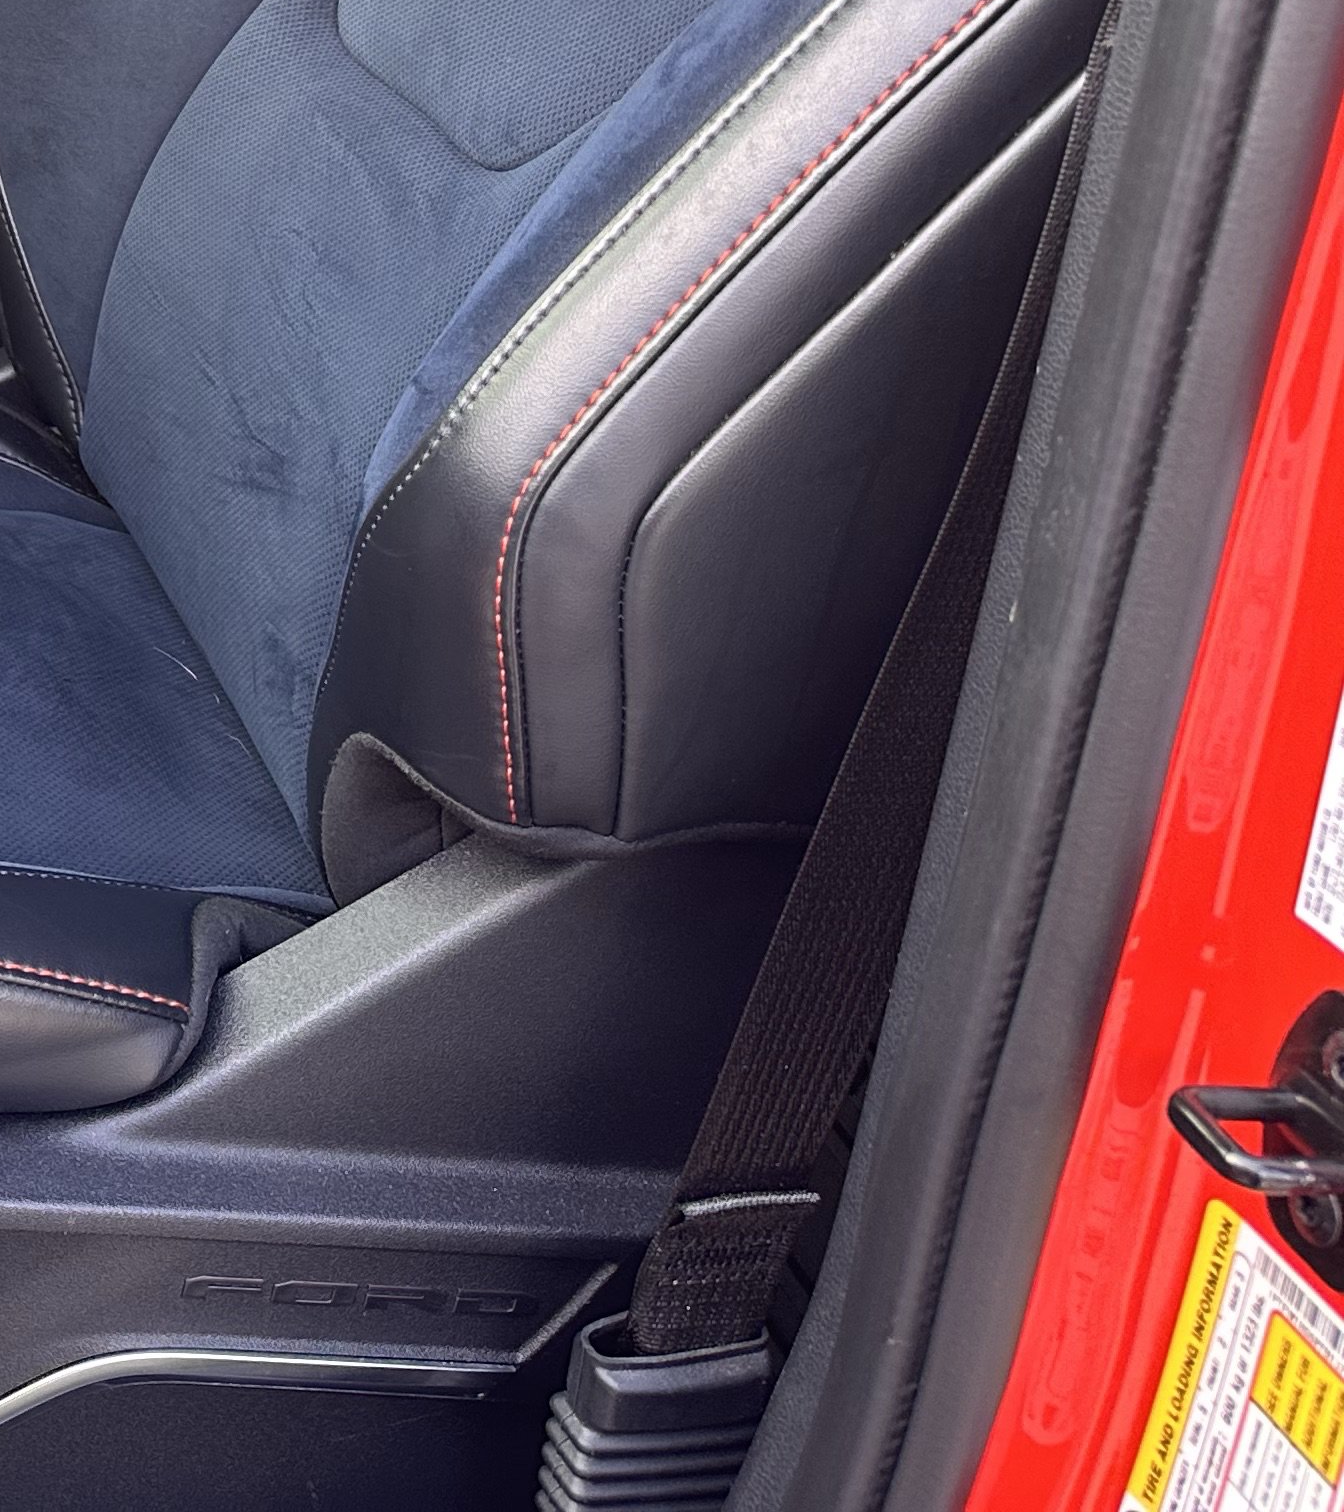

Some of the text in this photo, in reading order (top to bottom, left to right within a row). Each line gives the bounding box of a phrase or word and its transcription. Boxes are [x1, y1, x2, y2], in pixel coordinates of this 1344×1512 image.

[1141, 1459, 1163, 1504] TIRE
[1156, 1423, 1174, 1464] AND
[1168, 1344, 1199, 1423] LOADING
[1192, 1216, 1233, 1343] INFORMATION
